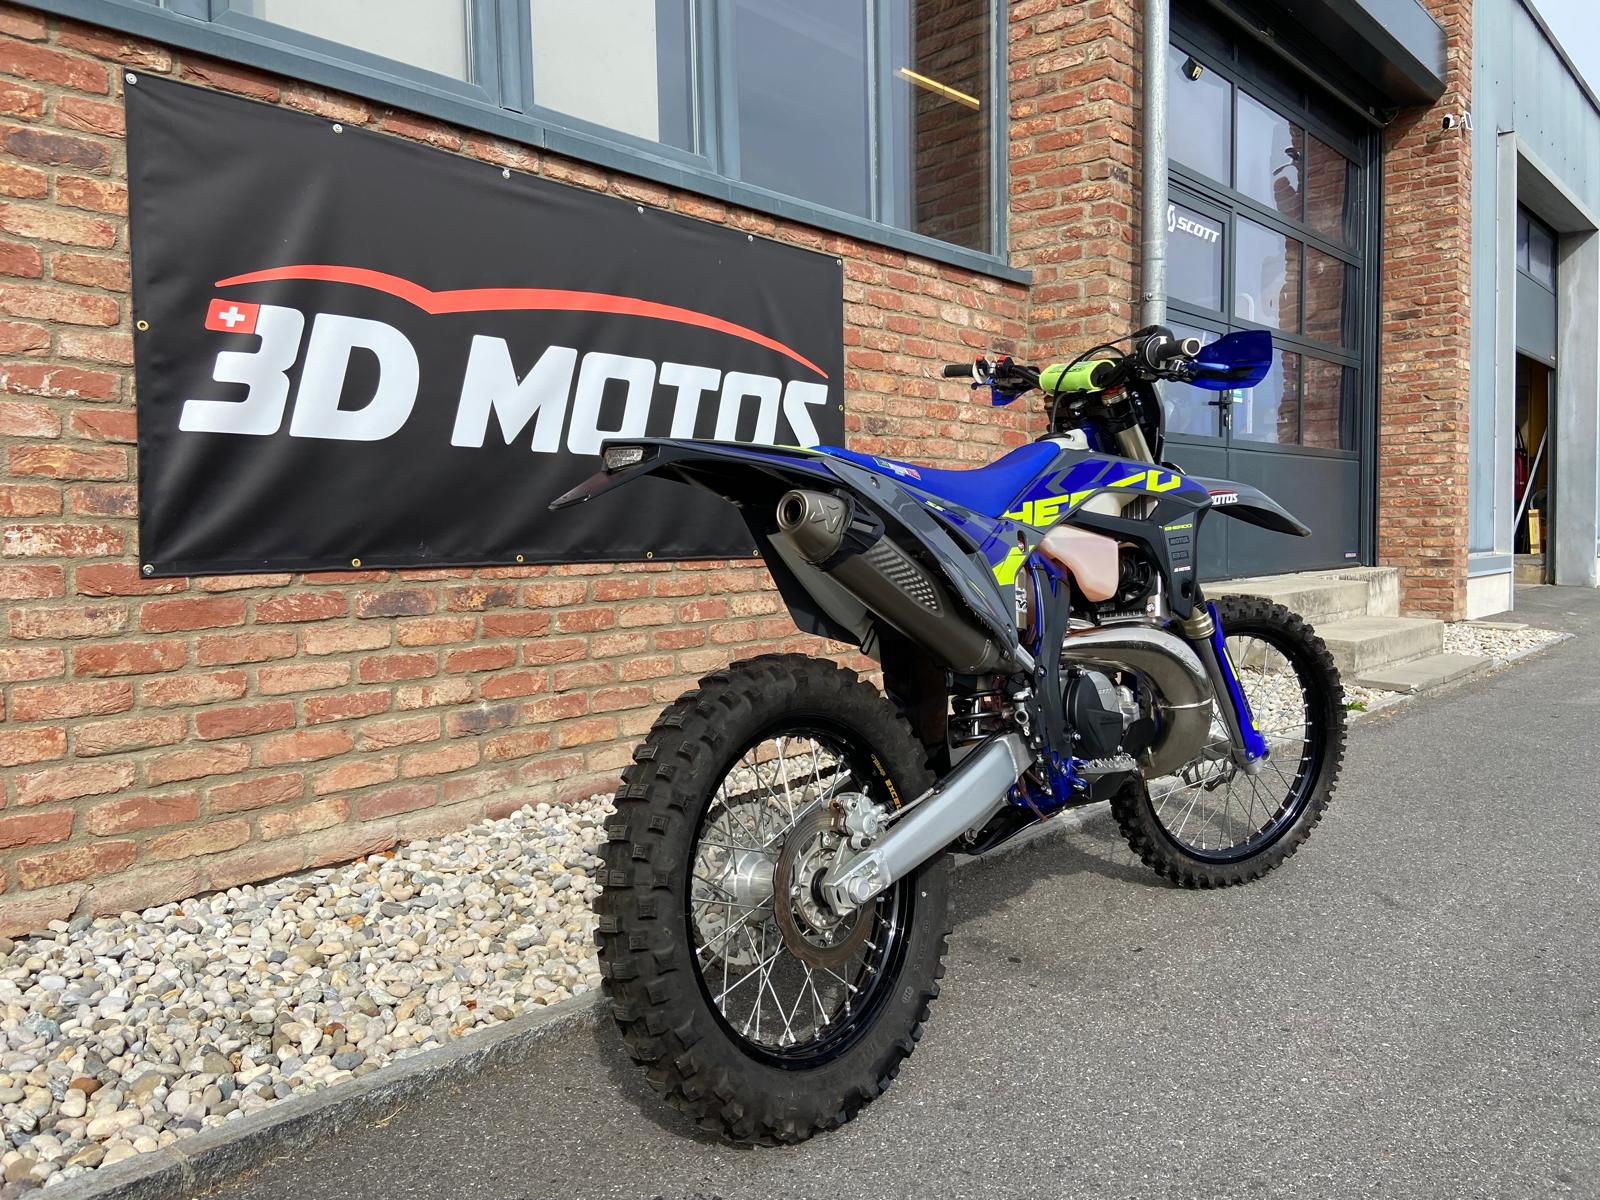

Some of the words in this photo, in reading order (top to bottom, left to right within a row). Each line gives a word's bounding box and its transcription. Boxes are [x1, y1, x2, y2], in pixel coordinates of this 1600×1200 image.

[1176, 216, 1220, 243] SCOTT
[179, 302, 420, 442] 3D
[450, 334, 829, 456] MOTOS
